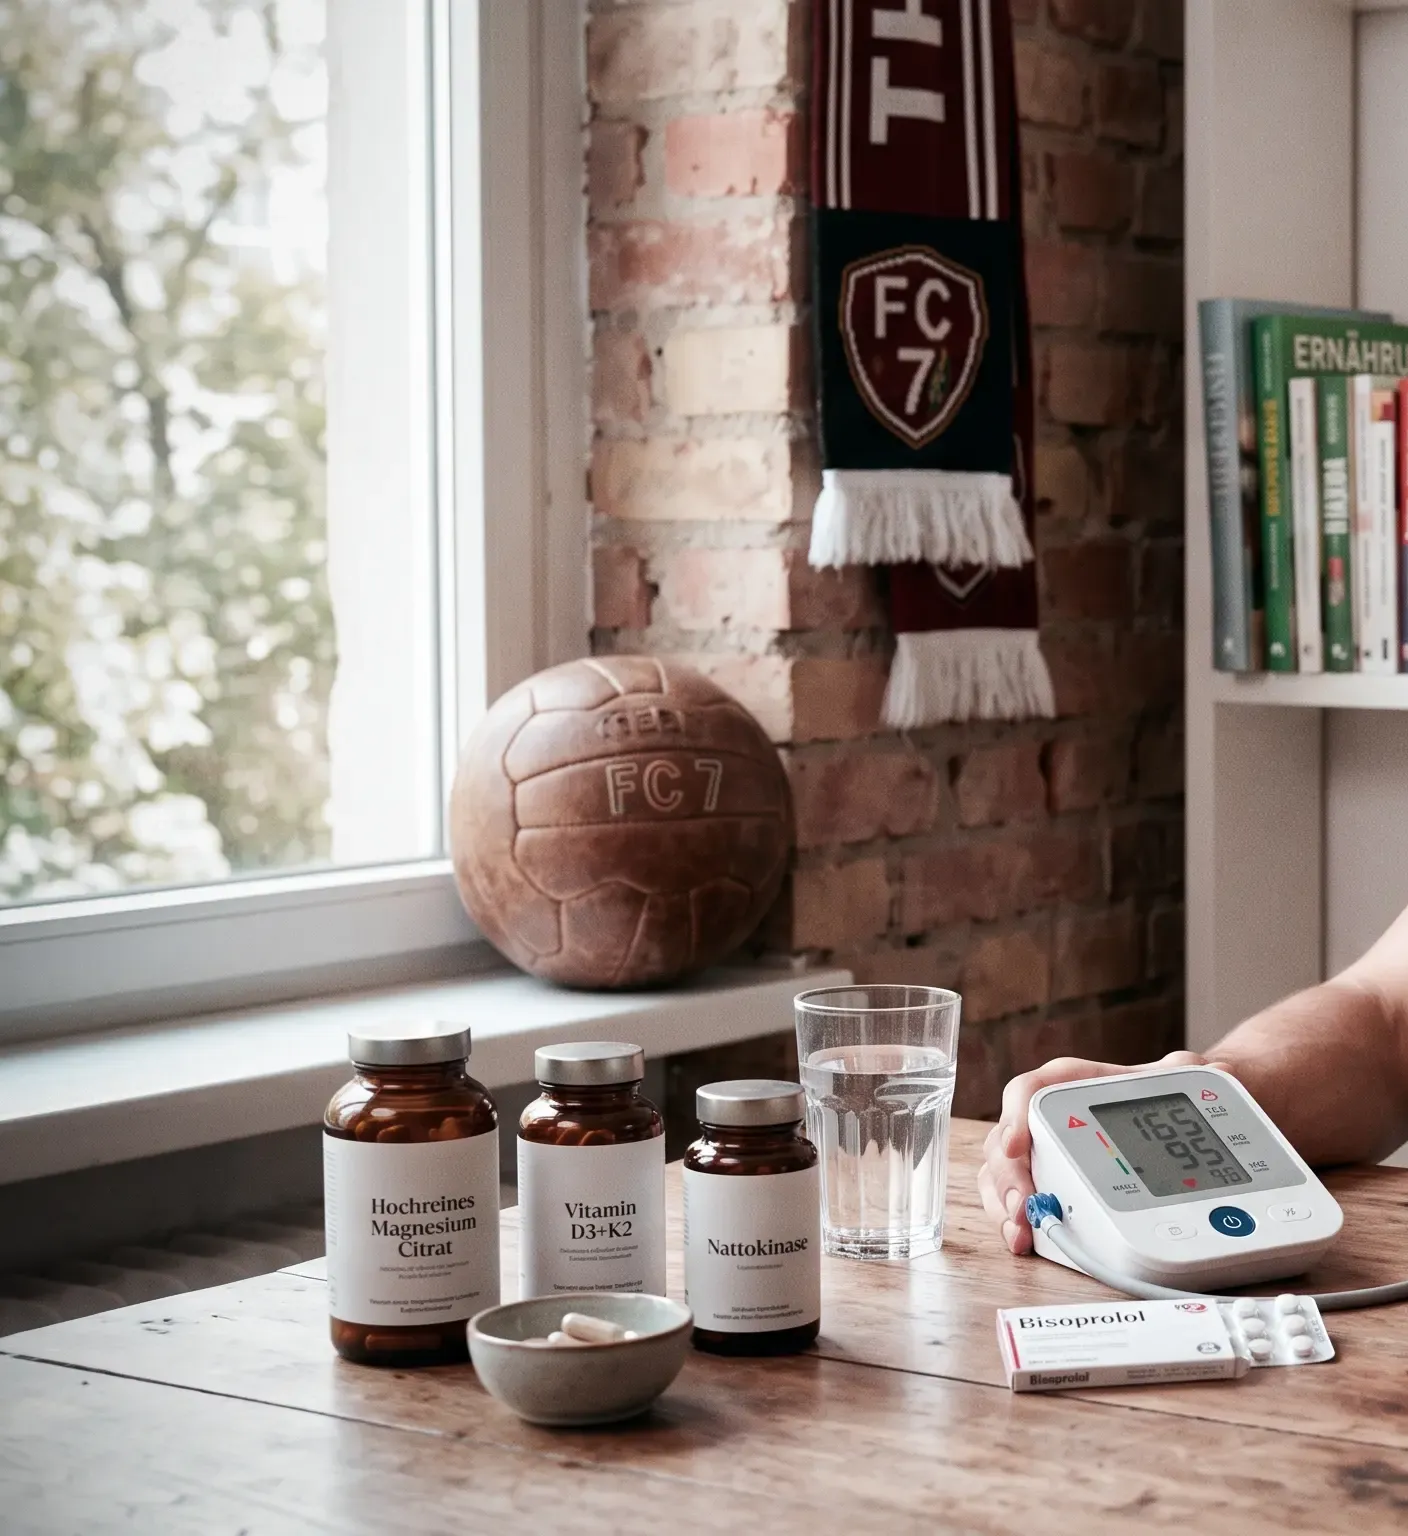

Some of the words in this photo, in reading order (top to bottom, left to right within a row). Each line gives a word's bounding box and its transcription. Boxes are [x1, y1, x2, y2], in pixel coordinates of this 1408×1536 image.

[873, 275, 952, 341] FC
[896, 347, 936, 415] 7
[605, 759, 684, 816] FC
[694, 758, 723, 812] 7
[1132, 1107, 1204, 1142] 165
[1164, 1136, 1225, 1171] 95
[371, 1196, 475, 1215] Hochreines
[564, 1201, 637, 1219] Vitamin
[371, 1217, 477, 1241] Magnesium
[571, 1220, 633, 1240] D3+K2
[398, 1240, 453, 1258] Citrat
[707, 1238, 809, 1257] Nattokinase
[1019, 1310, 1146, 1329] Bisoprolol
